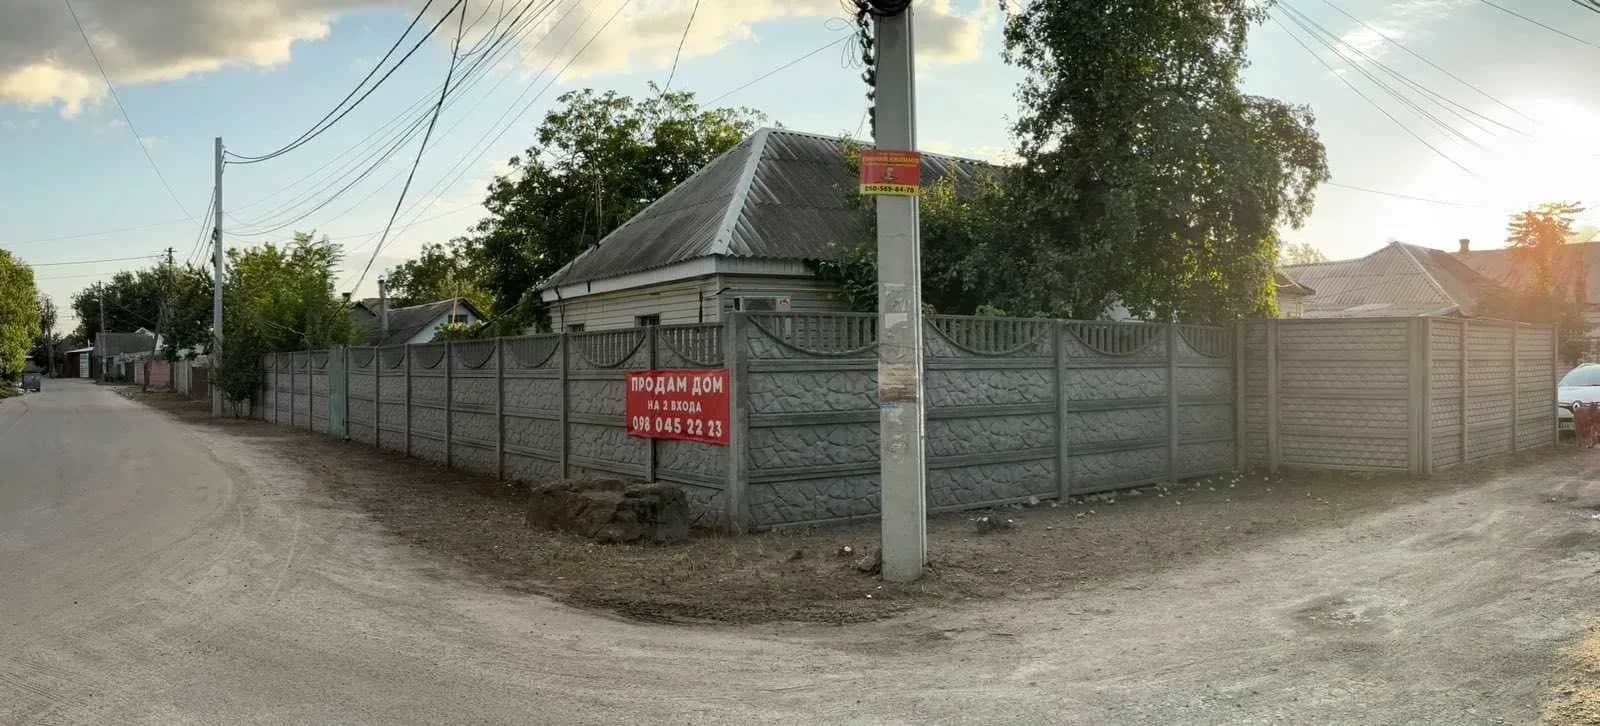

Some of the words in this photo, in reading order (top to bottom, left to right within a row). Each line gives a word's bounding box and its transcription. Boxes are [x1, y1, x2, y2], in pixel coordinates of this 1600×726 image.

[631, 376, 687, 395] ПРОДАМ
[692, 376, 723, 396] ДОМ
[647, 400, 659, 410] НА
[663, 400, 668, 410] 2
[671, 400, 702, 413] ВХОДА
[632, 416, 650, 432] 098
[655, 417, 682, 433] 045
[687, 418, 703, 435] 22
[708, 420, 722, 437] 23
